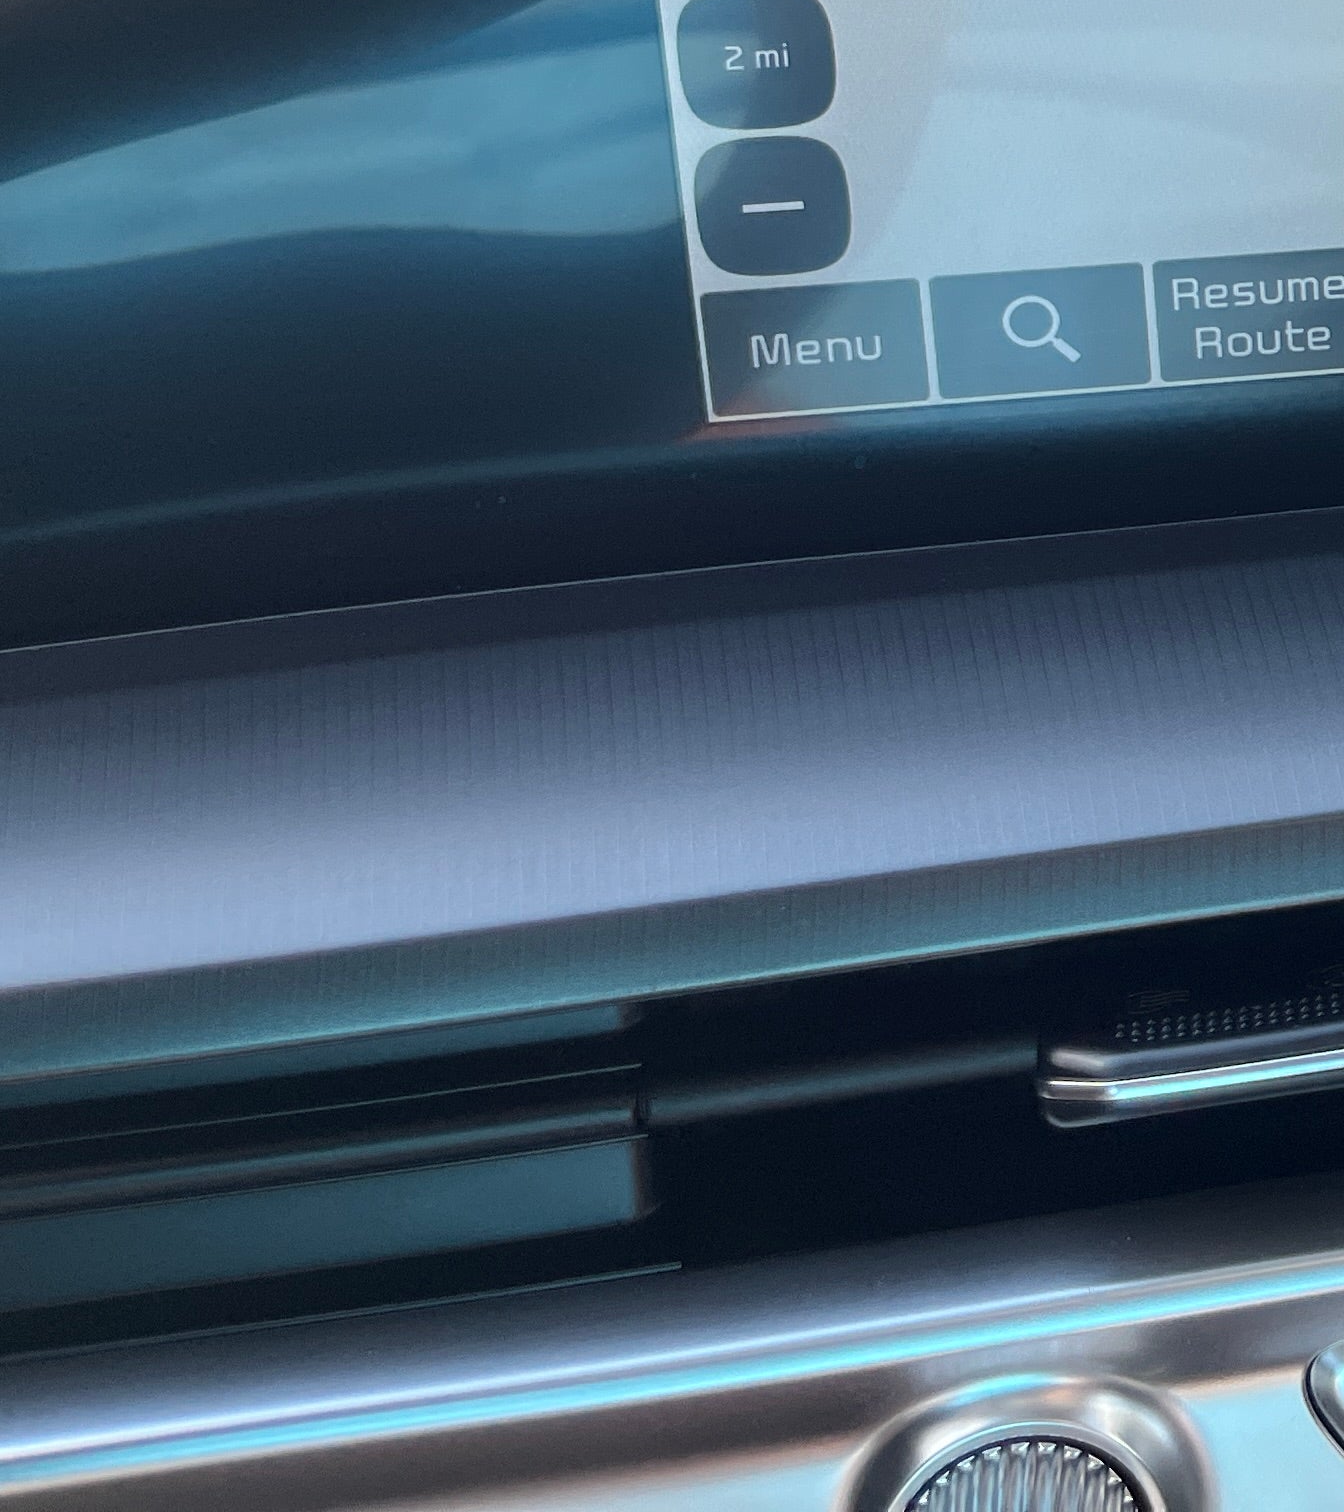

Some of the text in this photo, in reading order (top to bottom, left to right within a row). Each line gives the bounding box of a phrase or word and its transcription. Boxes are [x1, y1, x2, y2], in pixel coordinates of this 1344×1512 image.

[723, 41, 790, 71] 2 mi
[749, 330, 884, 370] Menu
[1194, 318, 1333, 362] Route
